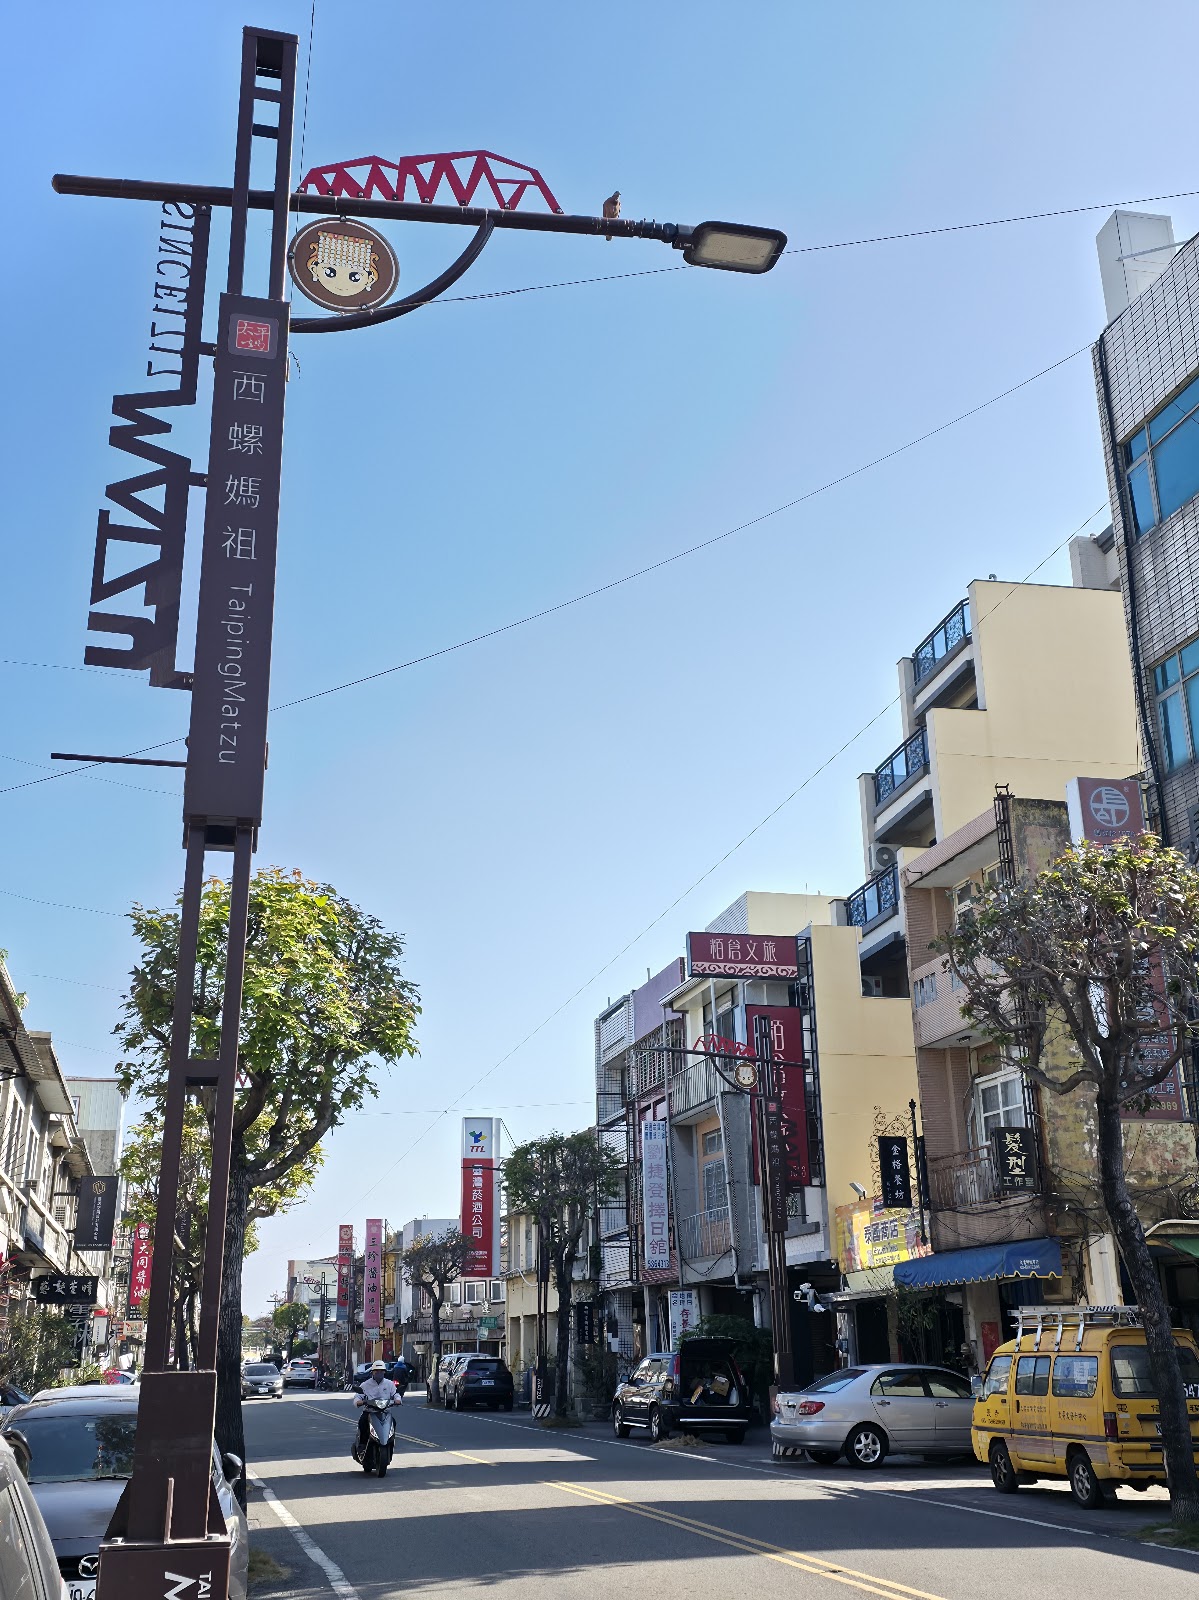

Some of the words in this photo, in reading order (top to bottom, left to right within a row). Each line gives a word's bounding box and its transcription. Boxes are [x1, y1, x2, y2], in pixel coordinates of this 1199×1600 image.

[222, 370, 267, 560] 西螺媽祖
[217, 583, 253, 764] TaipingMatzu
[470, 1145, 486, 1153] TTL
[1002, 1132, 1029, 1175] 髮型
[1003, 1176, 1035, 1187] 工作室
[134, 1242, 149, 1298] 大同醬油
